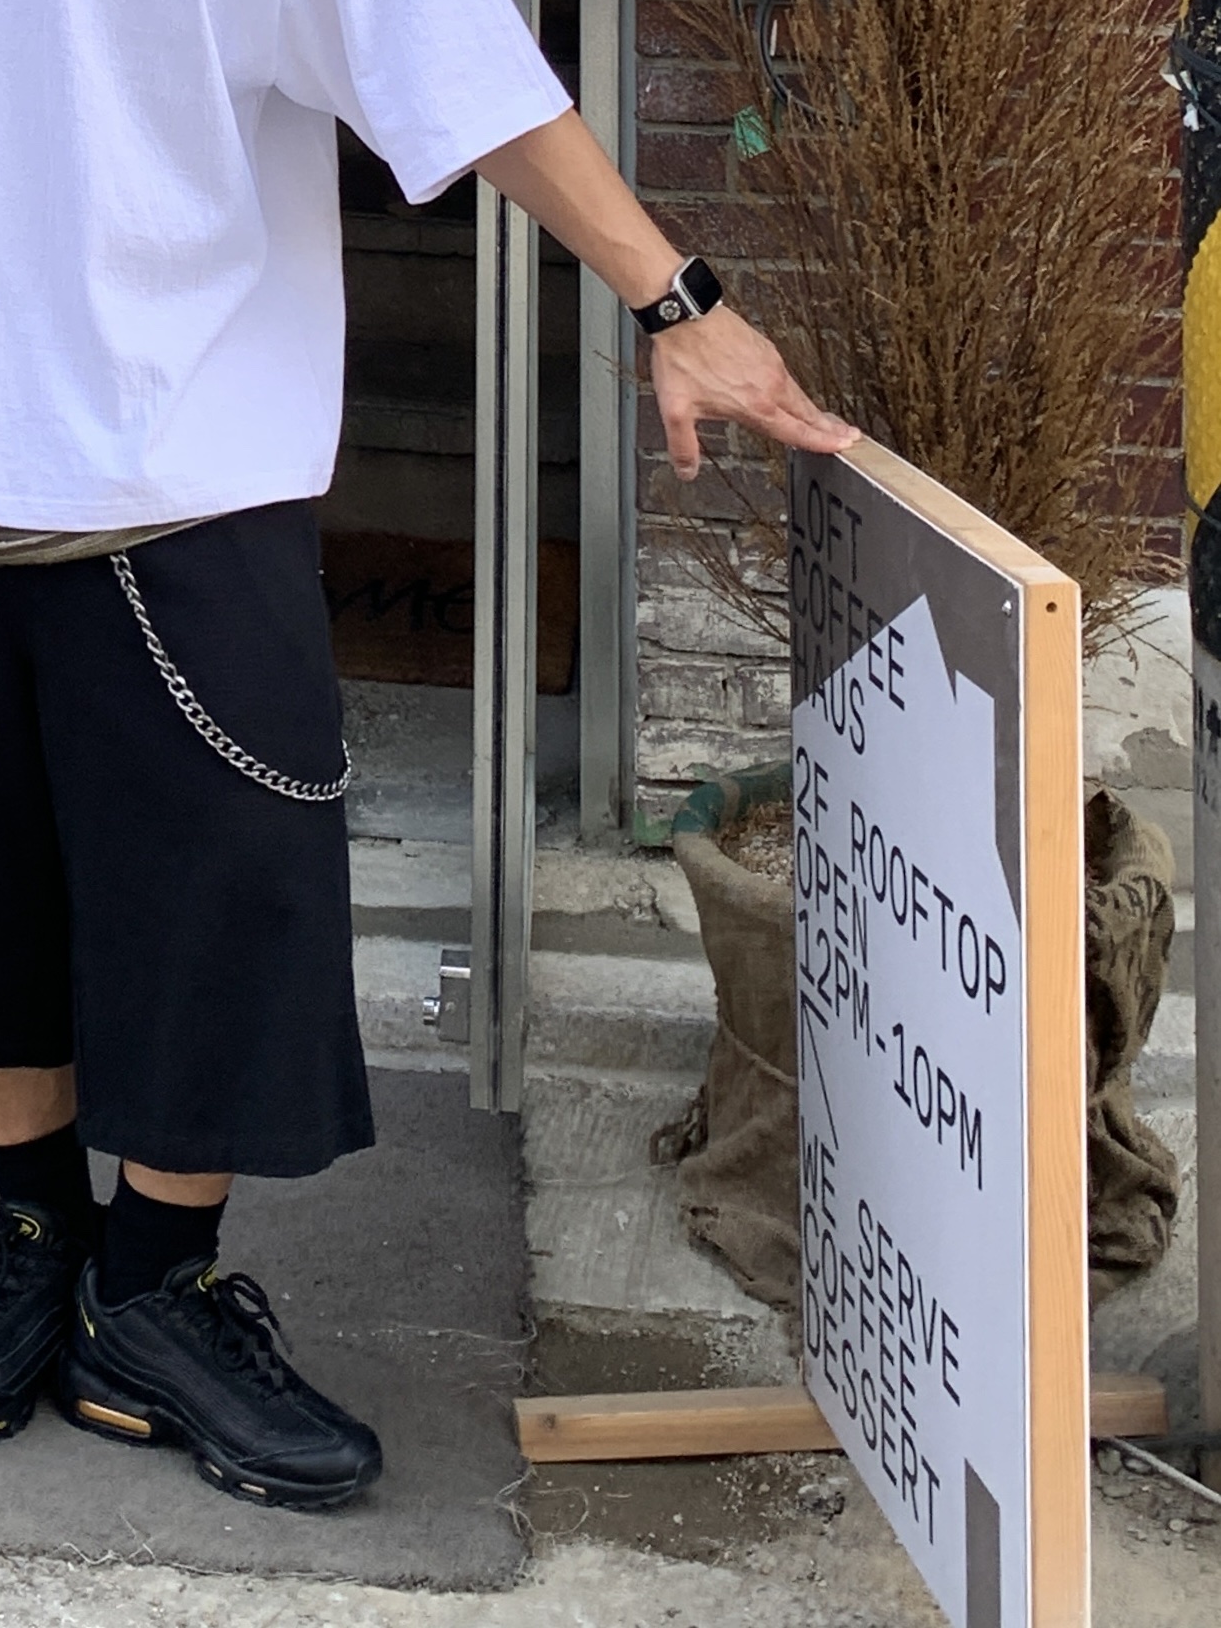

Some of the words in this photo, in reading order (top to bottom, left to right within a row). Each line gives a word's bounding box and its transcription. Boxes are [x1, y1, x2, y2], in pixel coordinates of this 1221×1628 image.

[790, 452, 863, 584] LOFT
[790, 544, 905, 712] COFFEE
[793, 619, 866, 755] HAUS
[796, 746, 829, 832] 2F
[851, 799, 1007, 1016] ROOFTOP
[797, 825, 868, 971] OPEN
[801, 1115, 836, 1229] WE
[858, 1198, 961, 1407] SERVE
[803, 1202, 917, 1431] COFFEE
[805, 1278, 941, 1546] DESSERT
